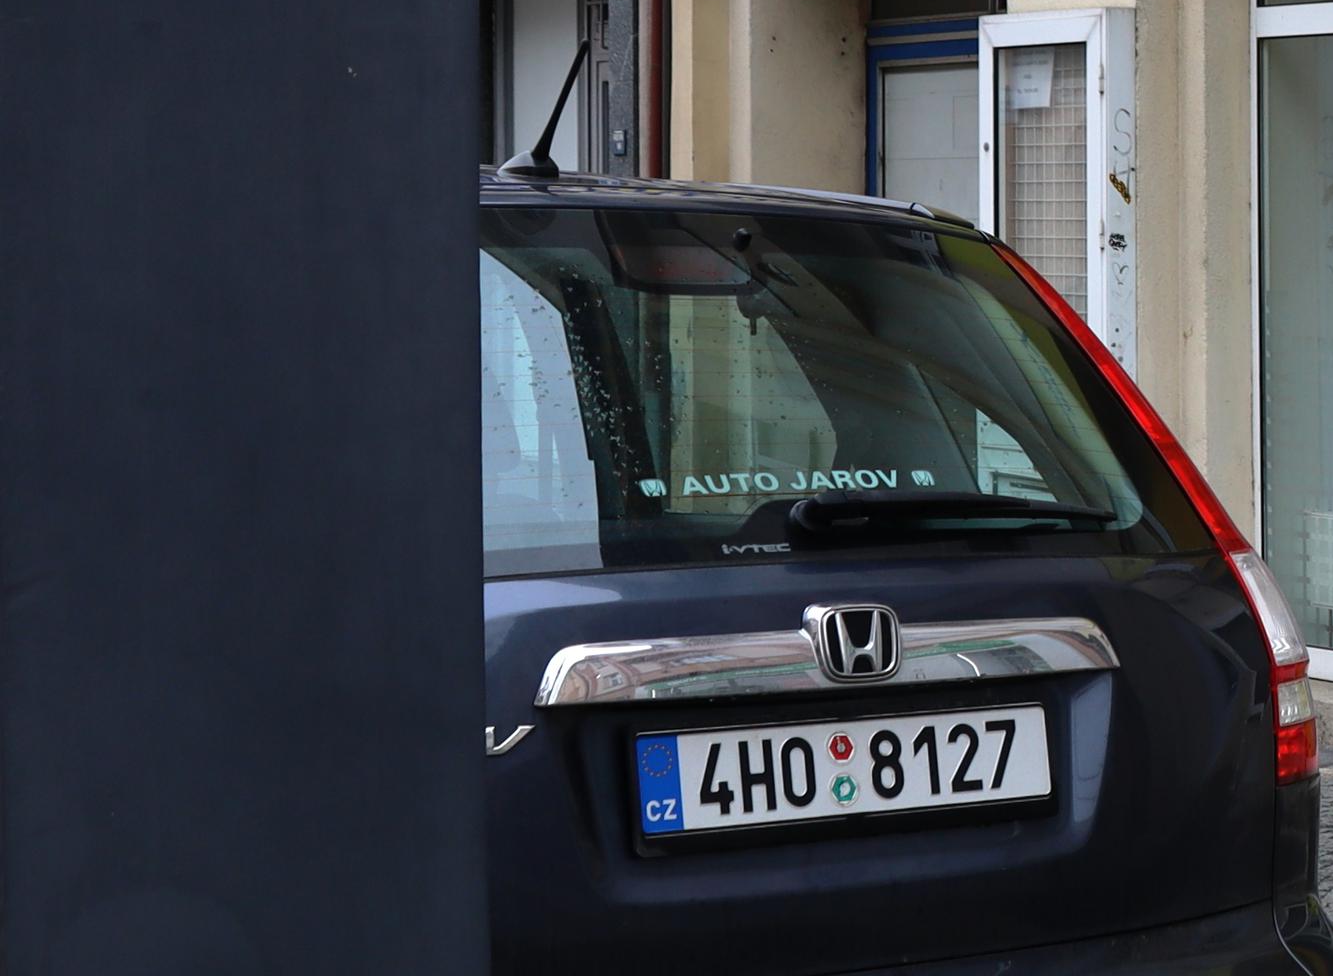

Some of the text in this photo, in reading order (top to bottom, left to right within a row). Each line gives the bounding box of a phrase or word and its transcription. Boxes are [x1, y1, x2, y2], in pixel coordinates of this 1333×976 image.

[683, 469, 898, 496] AUTO JAROV
[868, 718, 1018, 799] 8127
[646, 801, 678, 823] CZ
